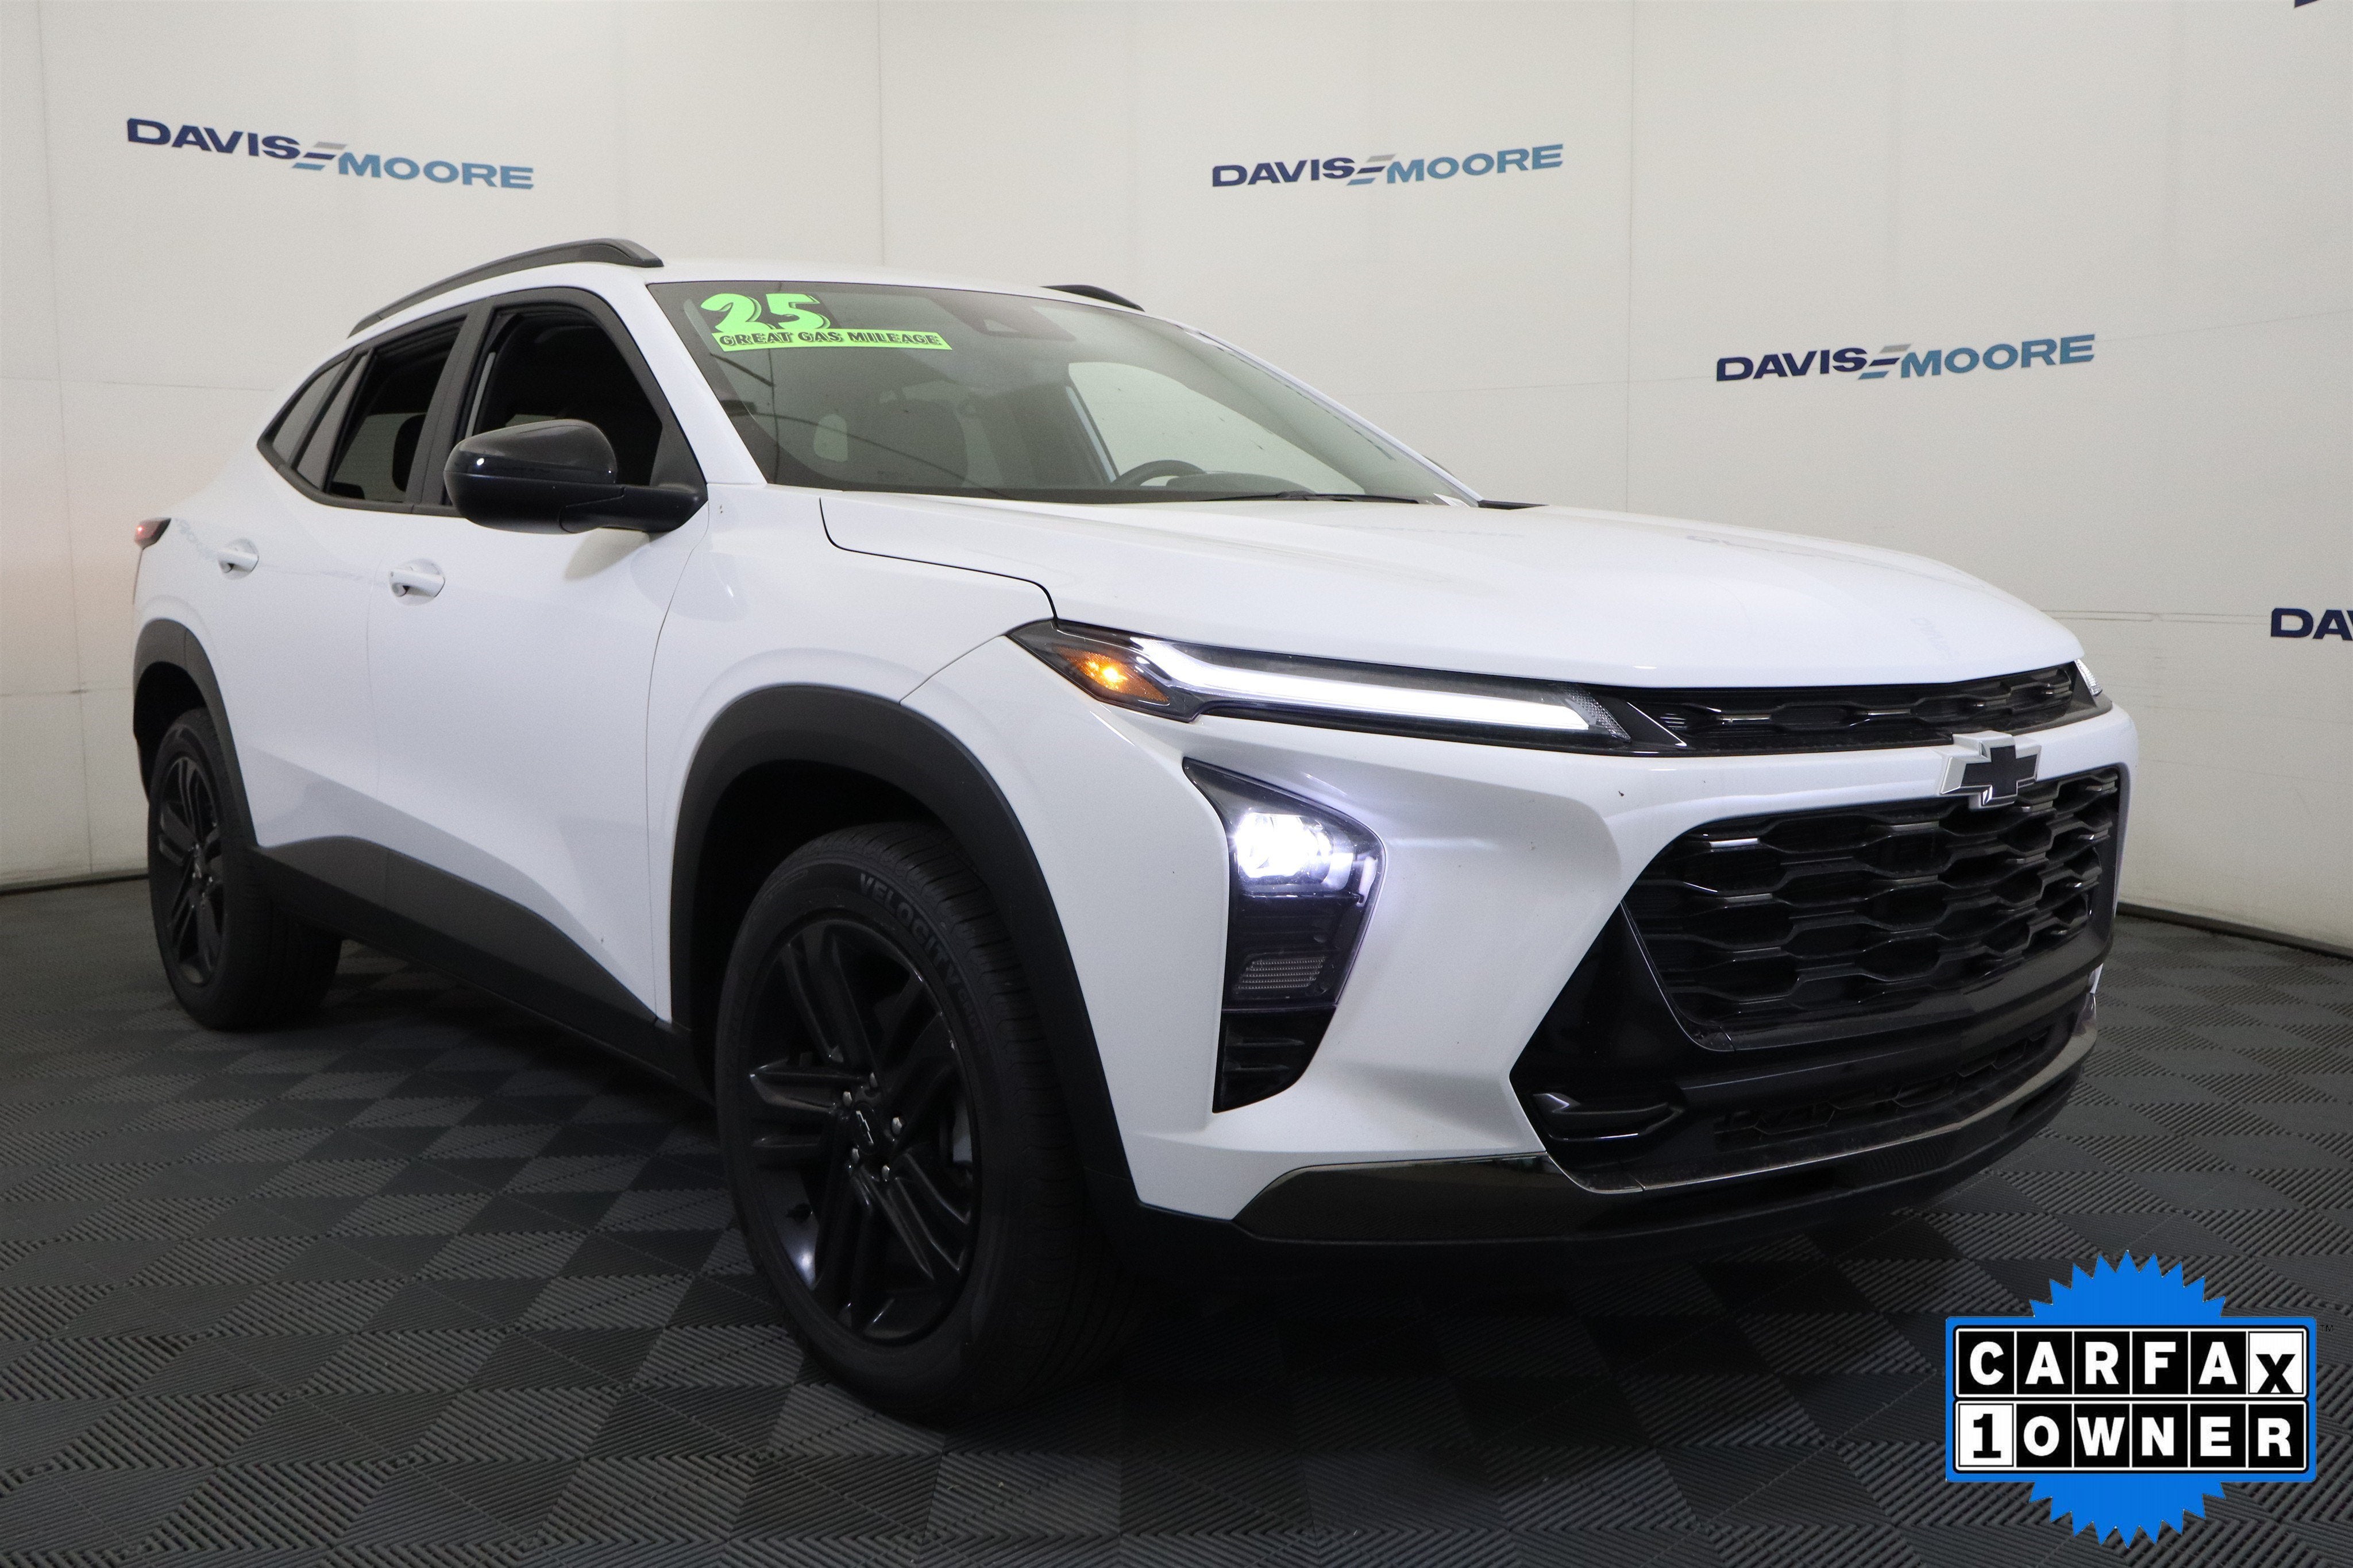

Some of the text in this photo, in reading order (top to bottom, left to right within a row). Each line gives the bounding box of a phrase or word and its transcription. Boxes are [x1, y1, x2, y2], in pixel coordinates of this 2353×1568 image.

[126, 118, 534, 190] DAVIS MOORE
[1212, 144, 1564, 187] DAVIS MOORE
[700, 293, 831, 332] 25
[719, 331, 943, 346] GREAT GAS MILEAGE
[1716, 334, 2096, 381] DAVIS MOORE
[2270, 608, 2353, 641] DA
[860, 872, 961, 987] VELOCITY
